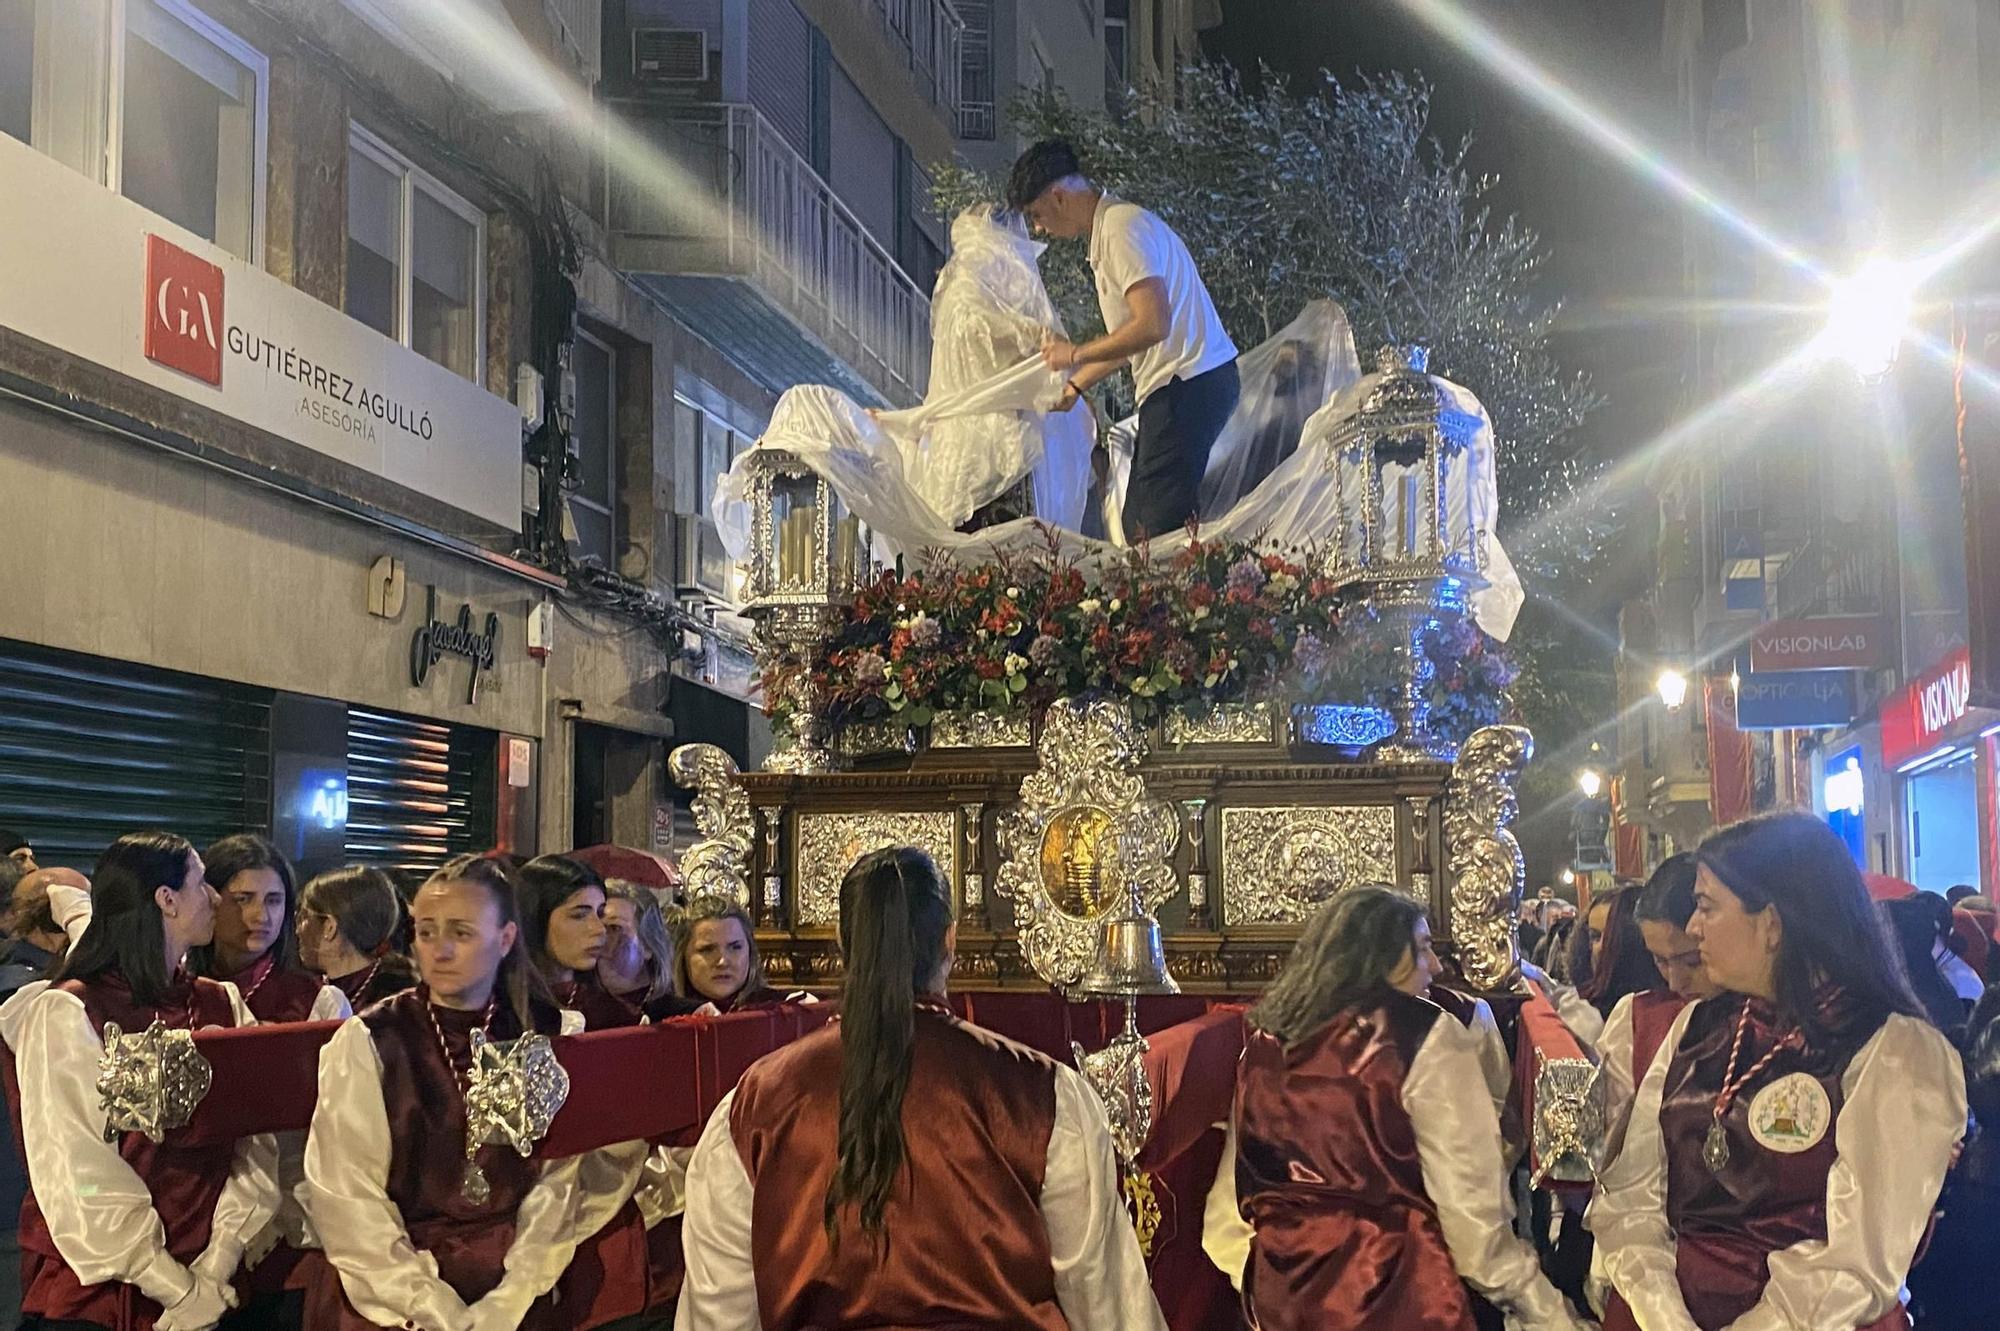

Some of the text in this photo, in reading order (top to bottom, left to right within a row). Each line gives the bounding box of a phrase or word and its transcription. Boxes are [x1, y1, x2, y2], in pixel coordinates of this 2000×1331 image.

[227, 325, 433, 441] GUTIÉRREZ AGULLÓ
[299, 396, 377, 445] ASESORÍA
[1757, 634, 1867, 655] VISIONLAB
[1741, 676, 1844, 702] OPTICLIA
